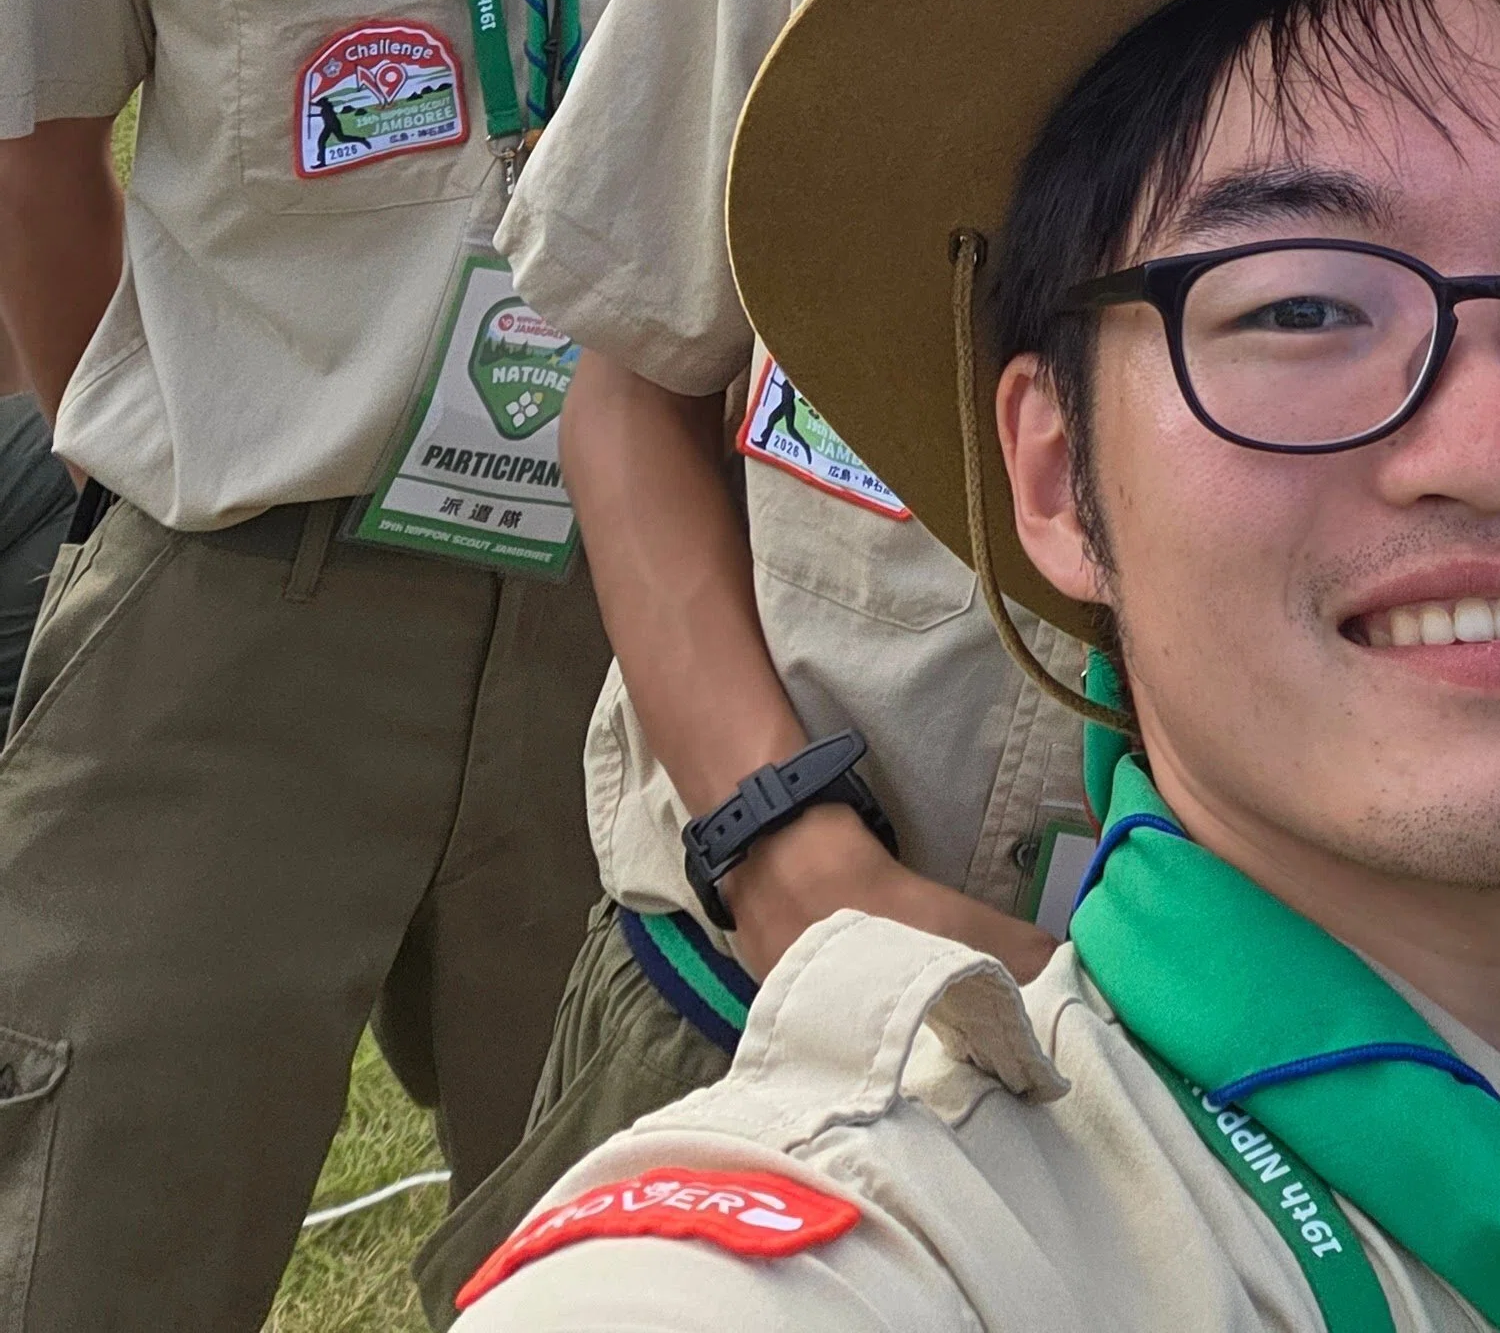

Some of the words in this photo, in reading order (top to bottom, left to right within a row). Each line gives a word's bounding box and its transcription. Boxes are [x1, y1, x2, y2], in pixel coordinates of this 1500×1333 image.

[345, 39, 434, 61] Challenge
[420, 96, 451, 112] SCOUT
[372, 105, 454, 136] JAMBOREE
[492, 365, 571, 393] NATURE
[421, 444, 564, 489] PARTICIPAN
[828, 465, 893, 496] 広島・神石
[404, 524, 452, 542] NIPPON
[451, 534, 491, 551] SCOUT
[1281, 1180, 1343, 1259] 19th
